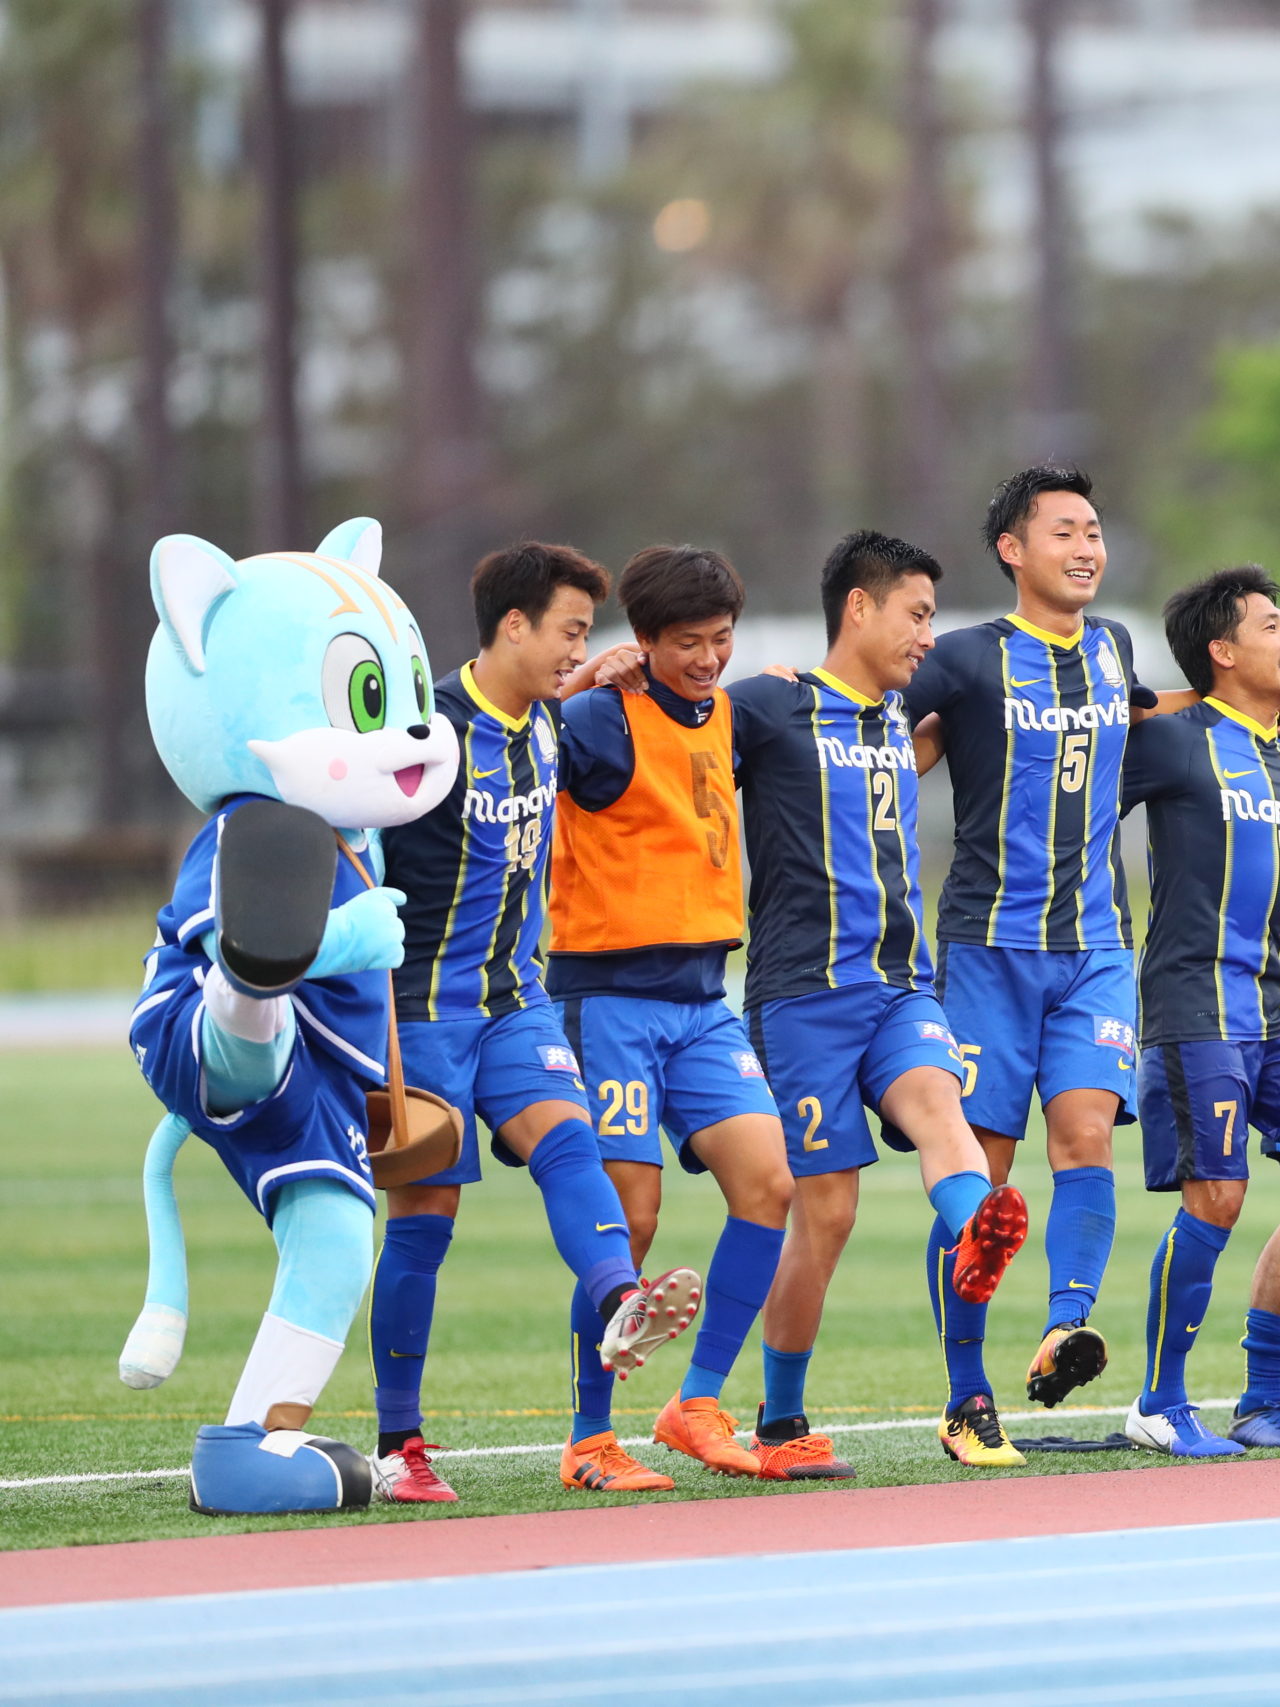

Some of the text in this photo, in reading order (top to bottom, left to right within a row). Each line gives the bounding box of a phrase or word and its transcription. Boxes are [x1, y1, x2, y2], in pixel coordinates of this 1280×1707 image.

[1061, 734, 1088, 793] 5
[690, 751, 730, 868] 5
[873, 771, 896, 830] 2
[504, 819, 542, 873] 19
[962, 1044, 982, 1098] 5
[598, 1079, 648, 1136] 29
[797, 1096, 829, 1152] 2
[1213, 1100, 1237, 1156] 7
